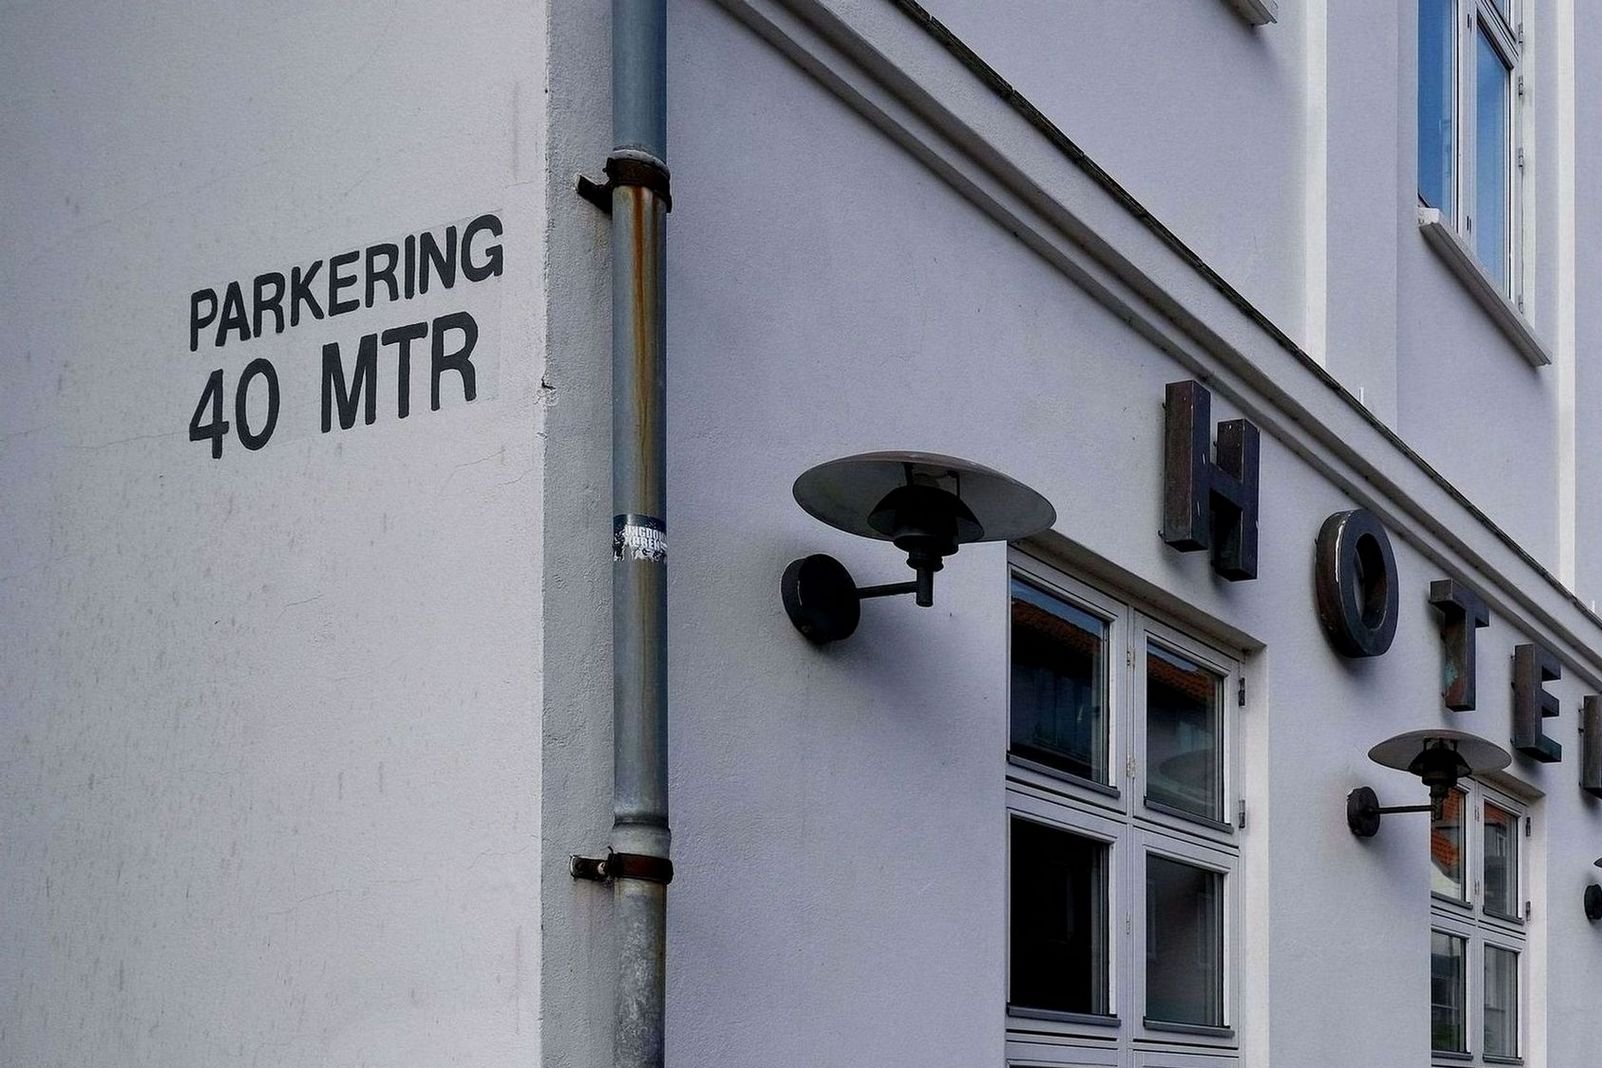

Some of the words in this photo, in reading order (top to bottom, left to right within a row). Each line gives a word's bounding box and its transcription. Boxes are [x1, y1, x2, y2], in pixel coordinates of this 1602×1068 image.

[190, 214, 504, 351] PARKERING
[189, 358, 281, 459] 40
[320, 311, 479, 433] MTR
